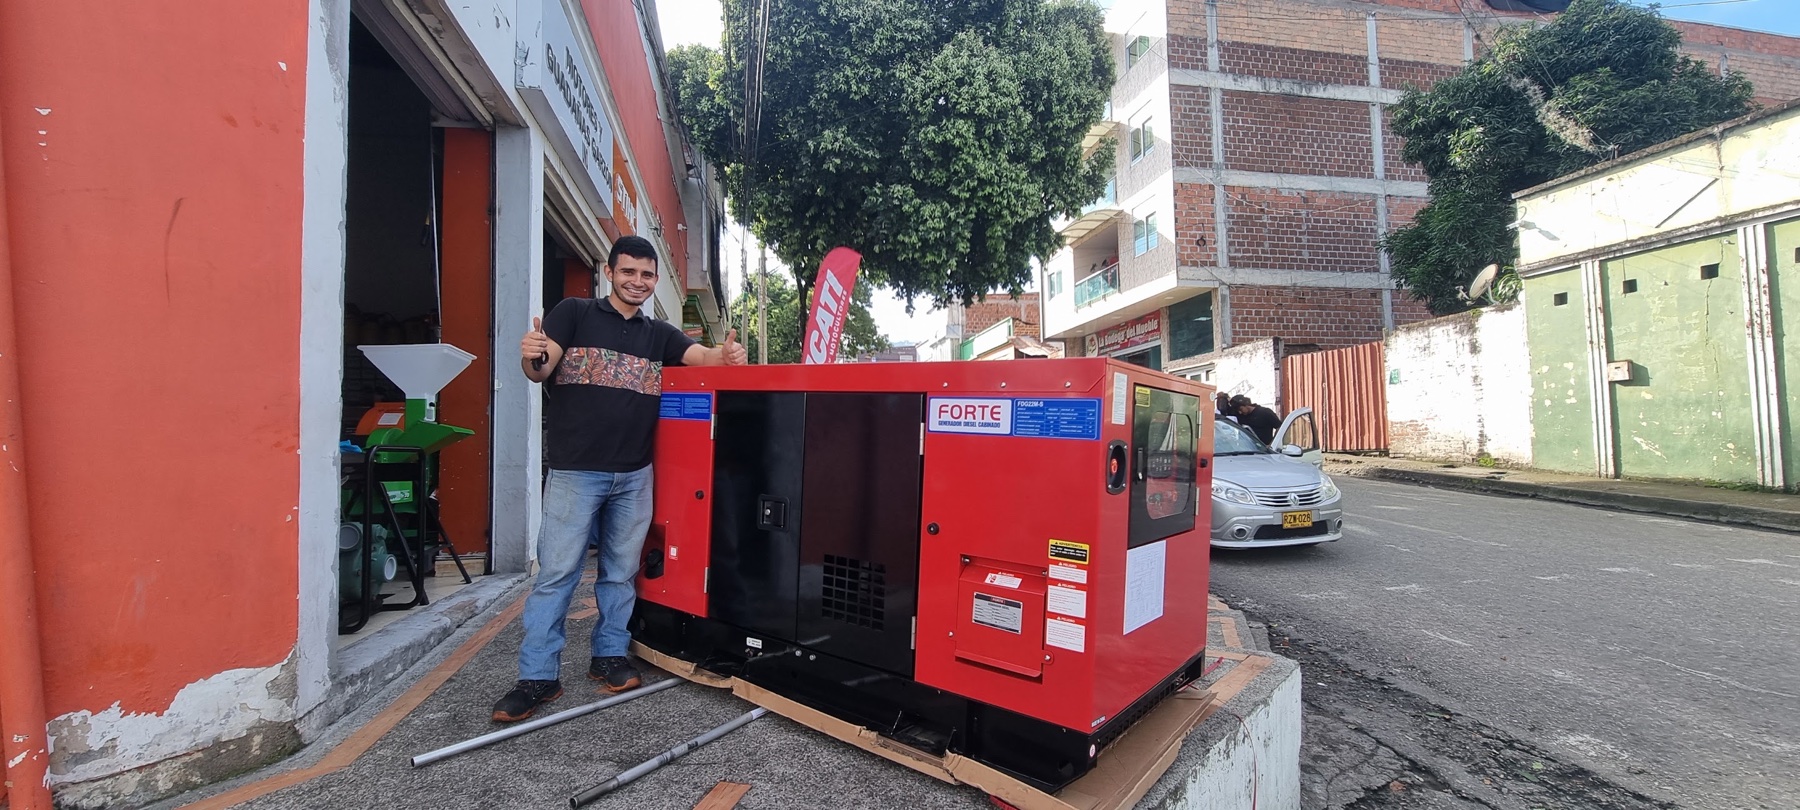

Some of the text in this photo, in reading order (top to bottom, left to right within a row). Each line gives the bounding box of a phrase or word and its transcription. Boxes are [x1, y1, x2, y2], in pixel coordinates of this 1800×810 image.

[566, 46, 597, 132] MOTORES
[805, 269, 844, 364] CATI
[829, 290, 847, 355] MOTOCULTORES
[938, 404, 1002, 421] FORTE
